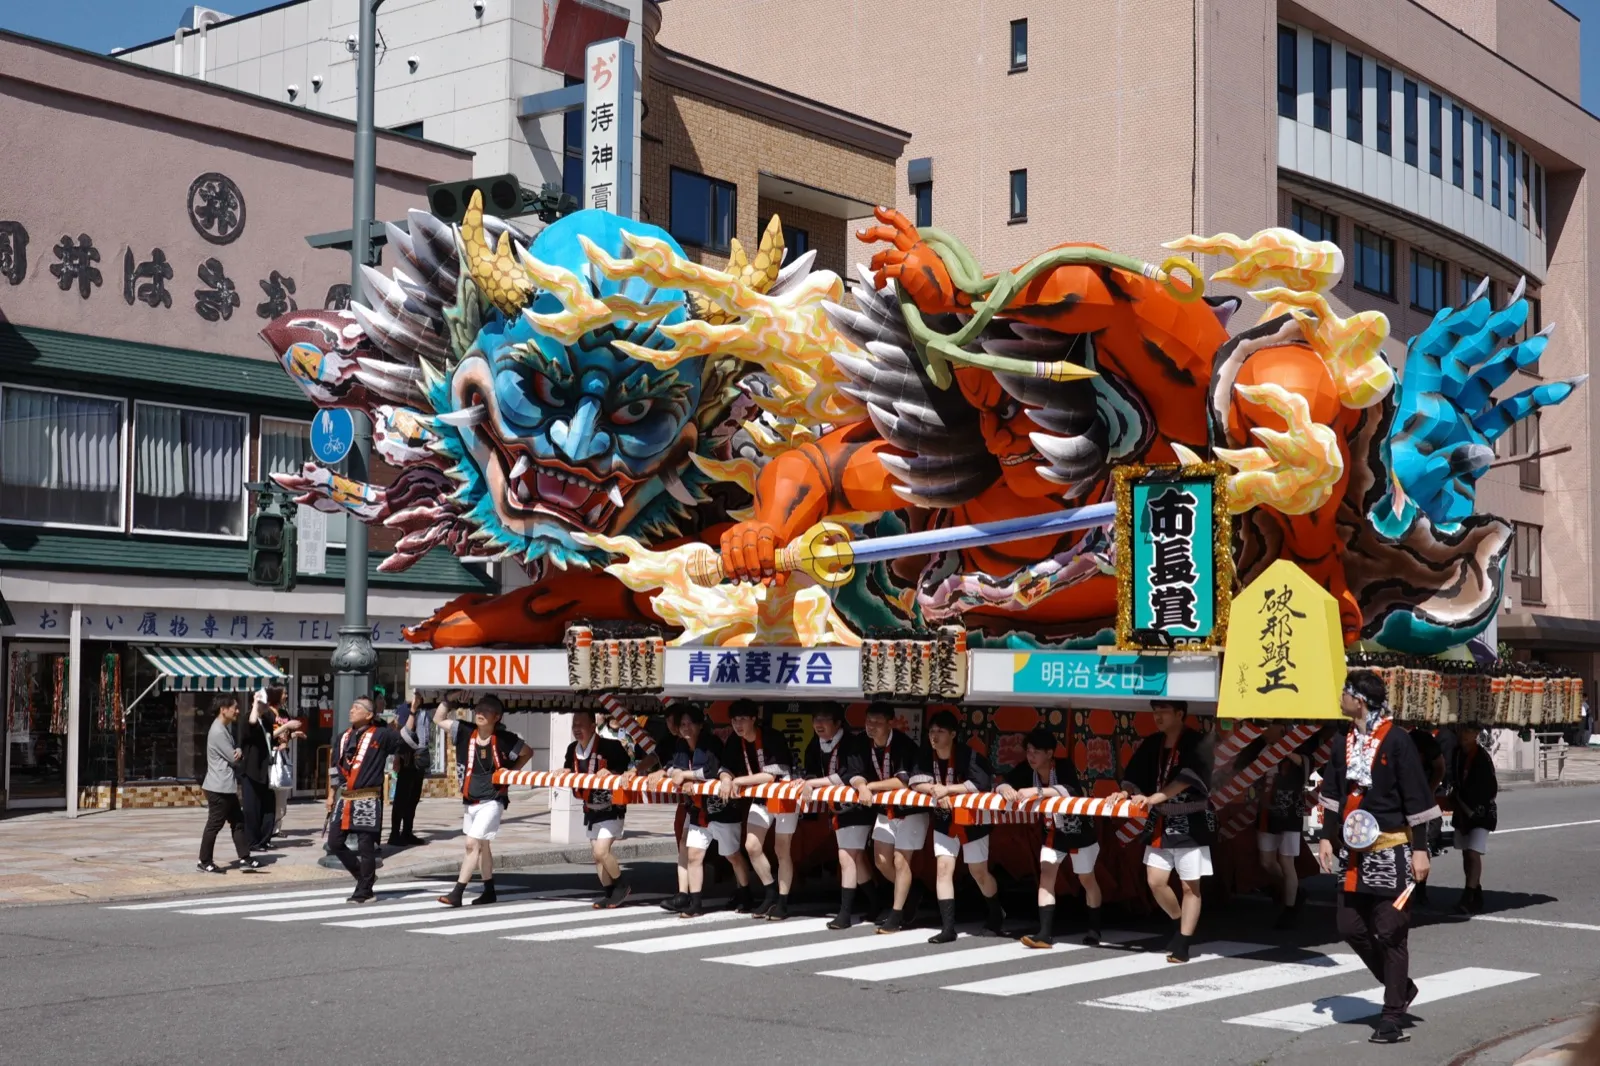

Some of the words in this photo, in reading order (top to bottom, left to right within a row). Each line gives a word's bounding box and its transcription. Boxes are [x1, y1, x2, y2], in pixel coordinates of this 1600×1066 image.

[1148, 488, 1198, 631] 市長賞
[300, 620, 332, 640] TEL
[448, 655, 529, 684] KIRIN
[689, 651, 832, 684] 青森菱友会
[1041, 661, 1143, 689] 明治安田
